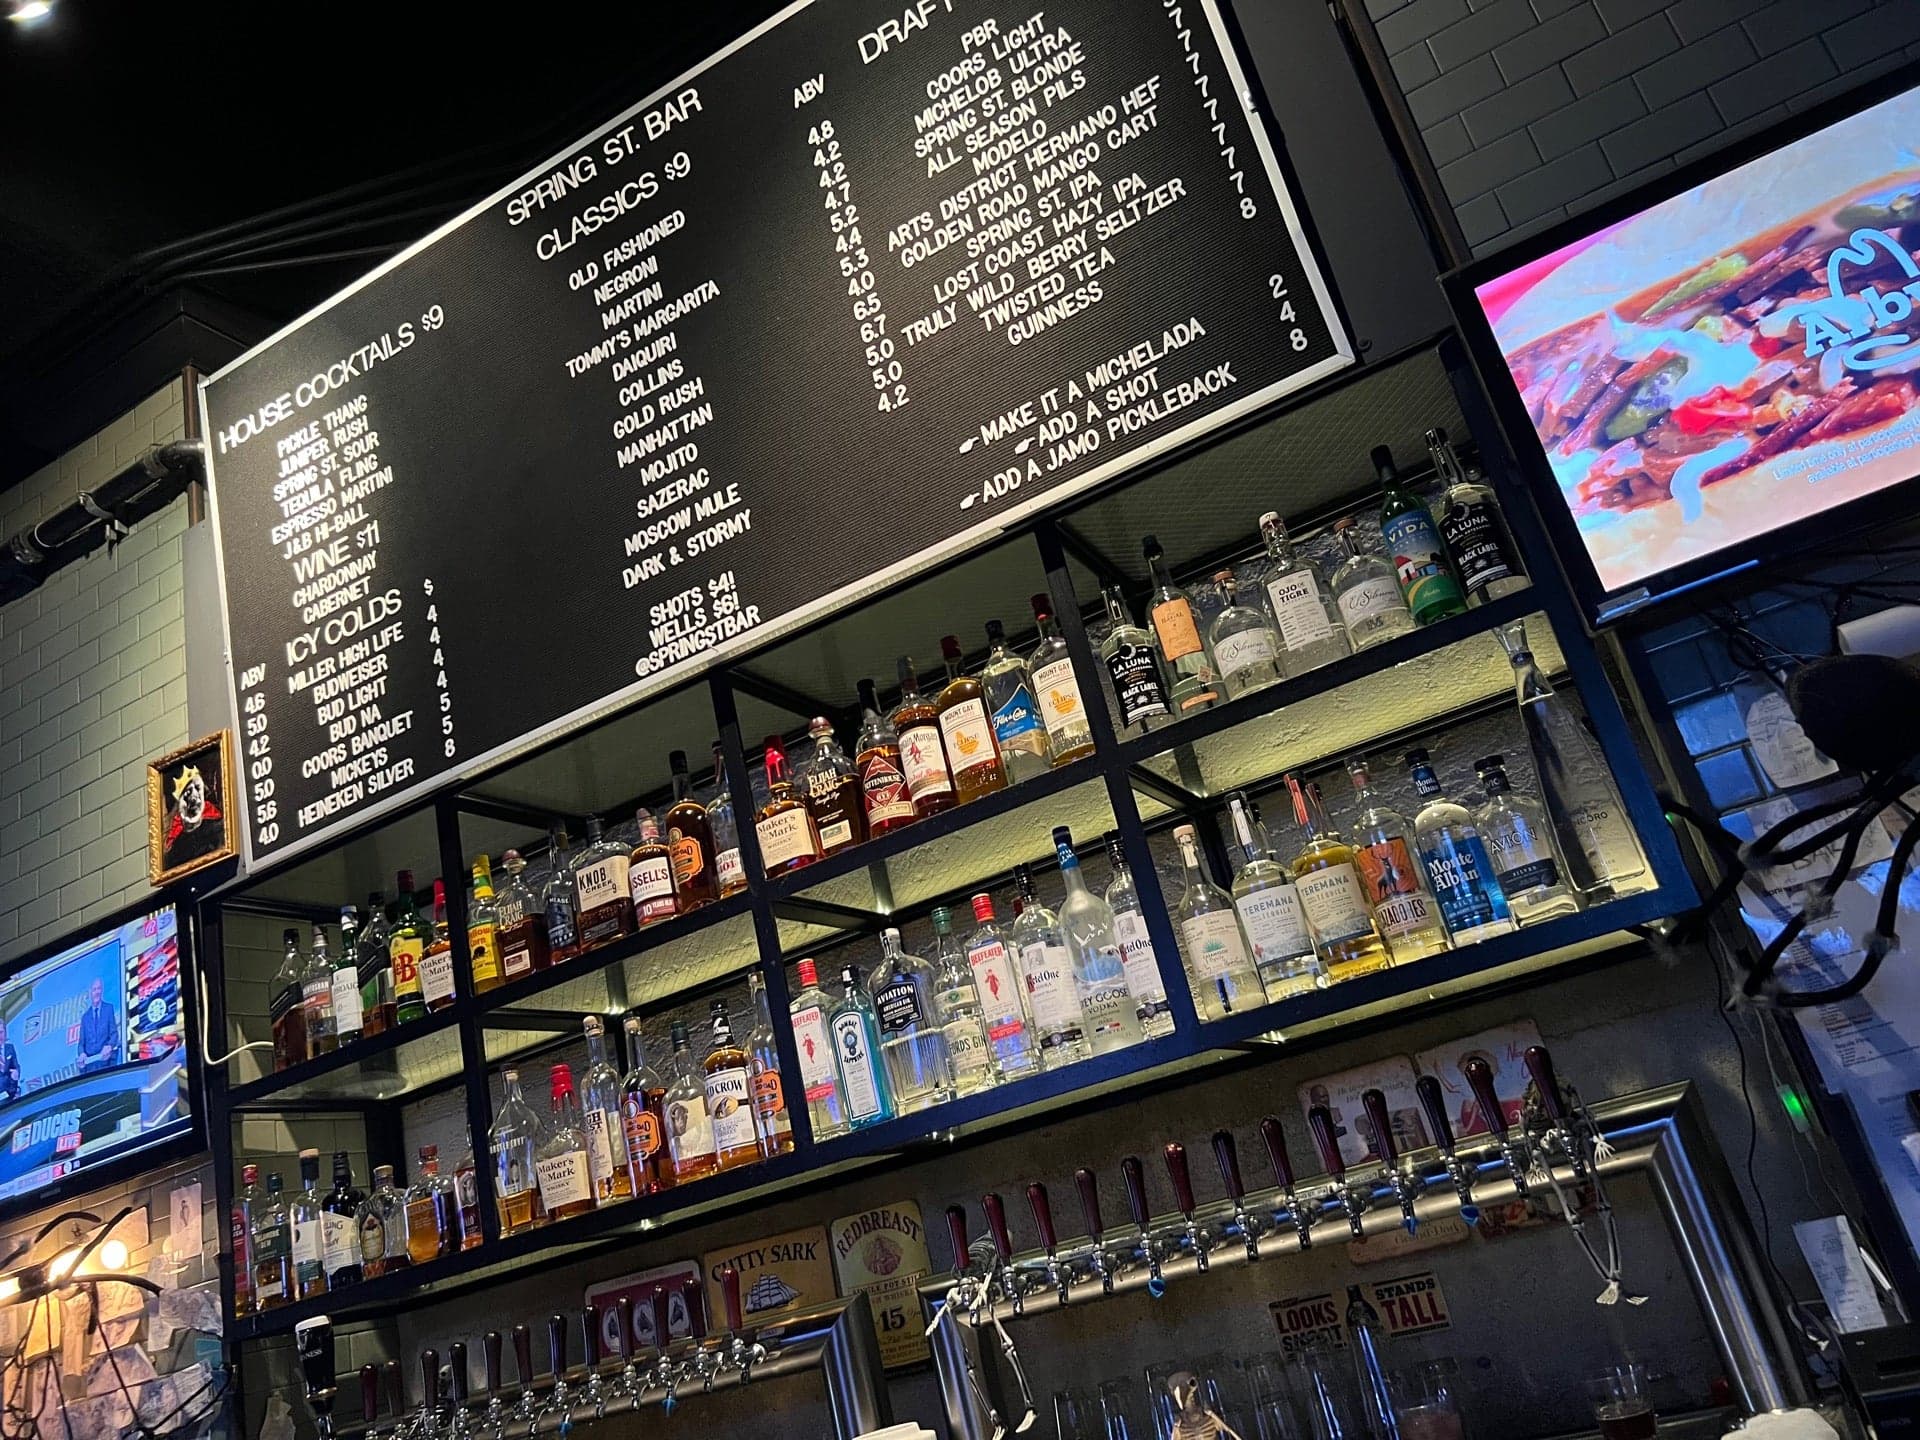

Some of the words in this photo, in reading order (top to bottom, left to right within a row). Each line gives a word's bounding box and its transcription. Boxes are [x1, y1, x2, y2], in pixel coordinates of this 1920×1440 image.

[926, 52, 986, 100] COORS
[991, 12, 1044, 61] LIGHT
[960, 18, 1000, 54] PBR
[793, 73, 824, 109] ABV
[914, 68, 1002, 134] MICHELOB
[1009, 26, 1072, 74] ULTRA
[914, 108, 977, 158] SPRING
[981, 89, 1009, 118] ST.
[1011, 41, 1086, 101] BLONDE
[927, 147, 963, 178] ALL
[965, 98, 1038, 154] SEASON
[1043, 69, 1087, 107] PILS
[972, 119, 1047, 176] MODELO
[506, 156, 598, 226] SPRING
[602, 126, 641, 166] ST.
[643, 88, 703, 141] BAR
[830, 204, 860, 233] 5.2
[888, 211, 934, 252] ARTS
[940, 159, 1017, 221] DISTRICT
[1024, 104, 1117, 172] HERMANO
[1120, 75, 1161, 115] HEF
[536, 172, 659, 261] CLASSICS
[664, 151, 691, 180] $9
[901, 213, 974, 268] GOLDEN
[977, 183, 1028, 226] ROAD
[1032, 142, 1100, 194] MANGO
[1107, 104, 1157, 150] CART
[966, 207, 1033, 258] SPRING
[1037, 187, 1066, 218] ST.
[1069, 170, 1102, 200] IPA
[568, 262, 599, 291] OLD
[603, 210, 686, 271] FASHIONED
[901, 301, 957, 347] TRULY
[966, 272, 1015, 312] WILD
[1026, 229, 1088, 280] BERRY
[1095, 177, 1187, 241] SELTZER
[933, 261, 979, 304] LOST
[985, 225, 1045, 275] COAST
[1052, 192, 1103, 238] HAZY
[1112, 172, 1147, 203] IPA
[593, 255, 659, 306] NEGRONI
[601, 281, 664, 330] MARTINI
[979, 272, 1066, 332] TWISTED
[1069, 246, 1116, 282] TEA
[565, 329, 632, 378] TOMMY'S
[633, 279, 720, 341] MARGARITA
[860, 313, 886, 343] 6.7
[1007, 280, 1104, 346] GUINNESS
[219, 392, 295, 454] HOUSE
[295, 322, 416, 408] COCKTAILS
[421, 304, 444, 332] $9
[612, 331, 677, 382] DAIQUIRI
[619, 358, 685, 407] COLLINS
[980, 401, 1037, 446] MAKE
[1040, 387, 1060, 416] IT
[1067, 380, 1083, 404] A
[1085, 316, 1206, 394] MICHELADA
[613, 404, 655, 440] GOLD
[658, 376, 704, 416] RUSH
[878, 384, 910, 413] 4.2
[1038, 411, 1077, 448] ADD
[1086, 400, 1102, 424] A
[1107, 366, 1160, 413] SHOT
[277, 420, 321, 459] PICKLE
[323, 395, 368, 431] THANG
[333, 415, 369, 448] RUSH
[617, 402, 714, 469] MANHATTAN
[982, 467, 1022, 504] ADD
[1026, 458, 1042, 483] A
[1046, 428, 1100, 472] JAMO
[1107, 361, 1237, 442] PICKLEBACK
[273, 465, 318, 502] SPRING
[320, 452, 342, 475] ST.
[343, 431, 380, 462] SOUR
[279, 478, 335, 518] TEQUILA
[339, 453, 378, 487] FLING
[637, 467, 710, 518] SAZERAC
[640, 442, 698, 487] MOJITO
[271, 497, 337, 546] ESPRESSO
[341, 465, 394, 508] MARTINI
[283, 531, 313, 560] J&B
[315, 503, 370, 541] HI-BALL
[624, 507, 691, 557] MOSCOW
[694, 482, 742, 522] MULE
[293, 536, 351, 584] WINE
[356, 520, 380, 549] $11
[622, 552, 666, 589] DARK
[670, 546, 684, 566] &
[686, 508, 751, 557] STORMY
[292, 550, 377, 608] CHARDONNAY
[303, 576, 371, 625] CABERNET
[650, 586, 703, 626] SHOTS
[708, 570, 736, 598] $4!
[1278, 584, 1297, 596] OJO
[1280, 588, 1309, 603] TIGRE
[286, 627, 321, 668] ICY
[324, 588, 401, 646] COLDS
[649, 607, 707, 649] WELLS
[712, 591, 740, 619] $6!
[241, 663, 266, 691] ABV
[288, 656, 336, 694] MILLER
[339, 639, 370, 670] HIGH
[372, 621, 405, 652] LIFE
[313, 653, 389, 705] BUDWEISER
[1113, 664, 1124, 675] LA
[1124, 656, 1151, 669] LUNA
[317, 699, 345, 726] BUD
[349, 675, 388, 709] LIGHT
[329, 717, 357, 743] BUD
[360, 703, 382, 728] NA
[302, 743, 348, 779] COORS
[351, 710, 414, 757] BANQUET
[331, 747, 389, 789] MICKEYS
[298, 781, 364, 828] HEINEKEN
[367, 757, 415, 794] SILVER
[579, 866, 607, 890] KNOB
[585, 879, 613, 893] CREEK
[1301, 875, 1349, 897] TEREMANA
[1428, 853, 1474, 877] Monte
[1243, 895, 1293, 917] TEREMANA
[877, 985, 914, 1005] AVIATION
[713, 1079, 743, 1093] CROW
[538, 1157, 575, 1175] Maker's
[547, 1167, 576, 1182] Mark
[711, 1250, 767, 1285] CUTTY
[770, 1239, 820, 1262] SARK
[836, 1209, 921, 1260] REDBREAST
[1275, 1301, 1338, 1334] LOOKS
[1375, 1278, 1435, 1301] STANDS
[1380, 1292, 1447, 1331] TALL
[880, 1306, 906, 1332] 15
